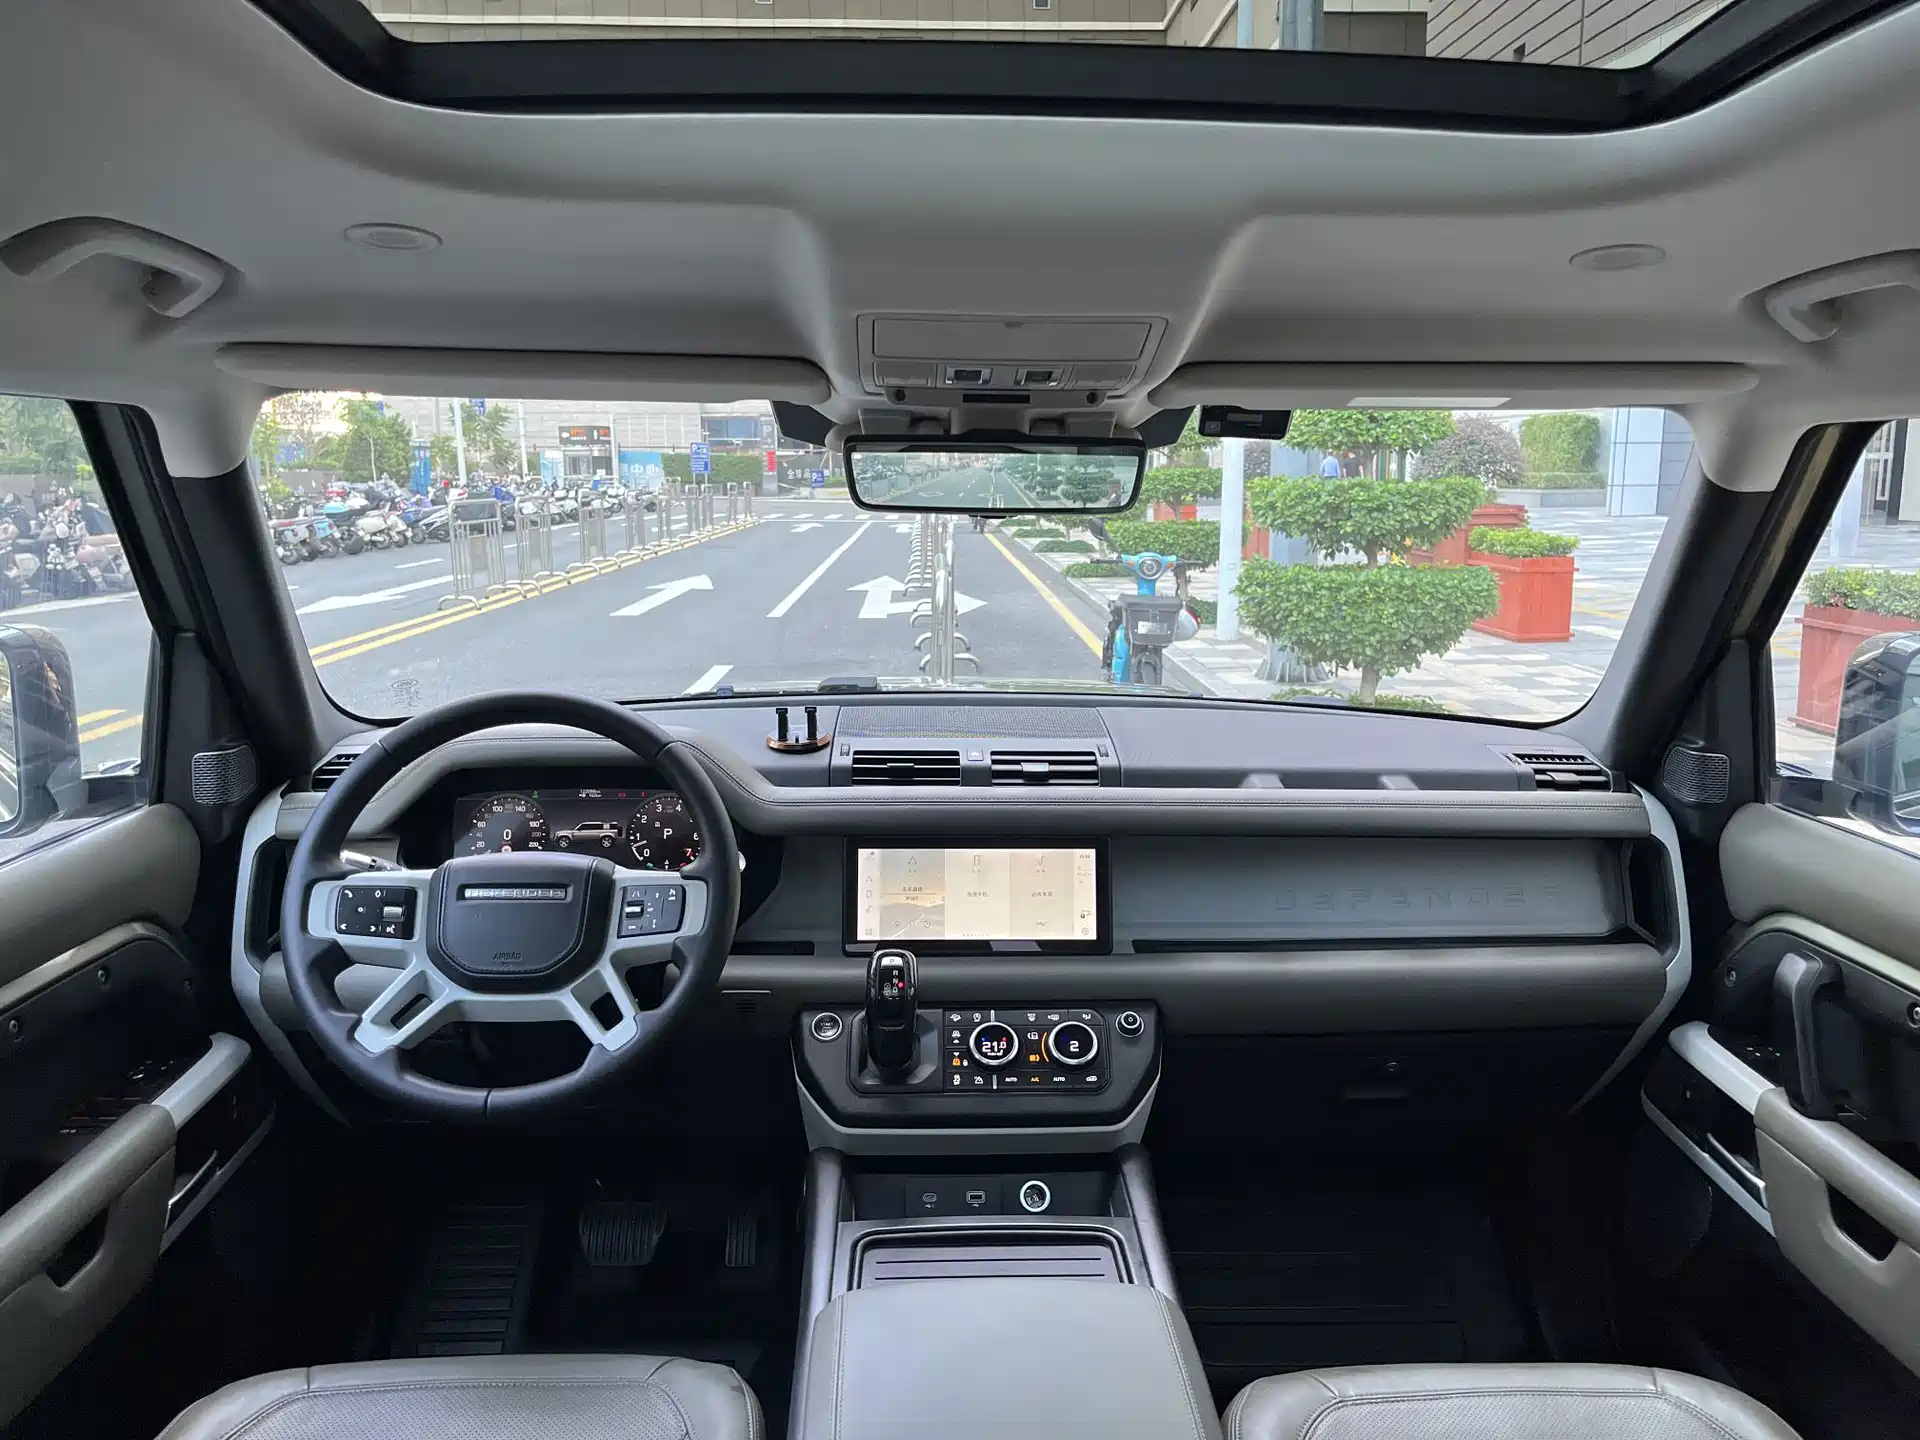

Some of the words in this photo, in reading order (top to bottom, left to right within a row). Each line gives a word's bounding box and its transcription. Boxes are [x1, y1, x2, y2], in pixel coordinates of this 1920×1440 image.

[656, 804, 662, 812] 3
[675, 804, 682, 812] 4
[641, 815, 648, 823] 2
[503, 829, 512, 840] 0
[663, 828, 673, 839] P
[643, 848, 650, 857] 0
[686, 848, 692, 857] 7
[493, 952, 522, 961] AIRBAG
[1069, 1040, 1080, 1052] 2
